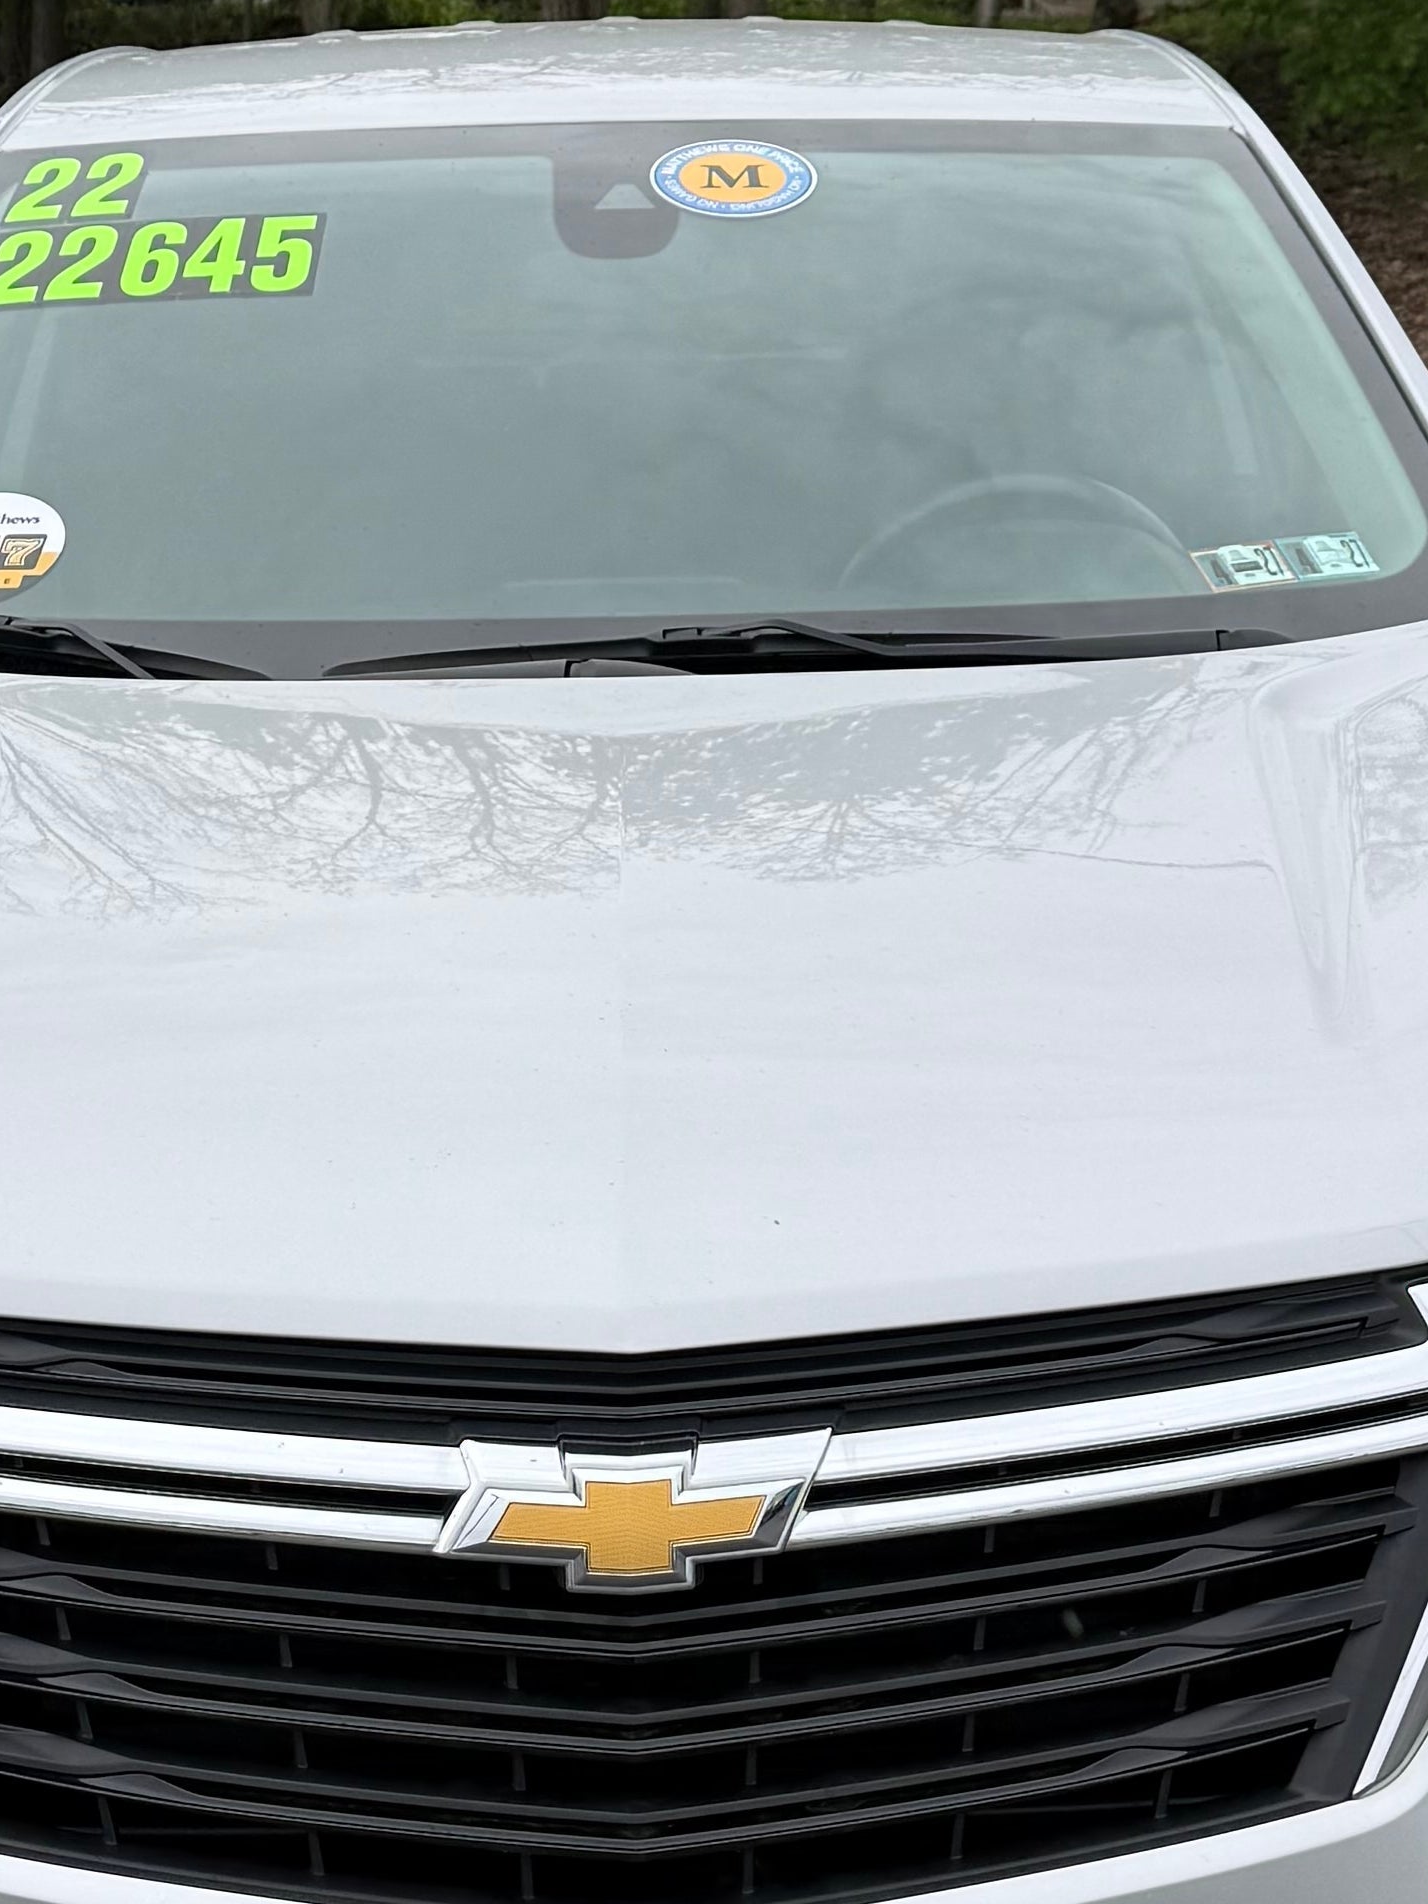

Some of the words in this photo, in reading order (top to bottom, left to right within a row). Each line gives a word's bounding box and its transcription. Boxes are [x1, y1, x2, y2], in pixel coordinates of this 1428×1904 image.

[661, 144, 730, 175] MATTHEWS
[733, 143, 767, 155] ONE
[768, 150, 805, 173] PRICE
[4, 152, 145, 224] 22
[700, 164, 770, 189] M
[1254, 547, 1284, 576] 27
[1340, 538, 1370, 568] 27
